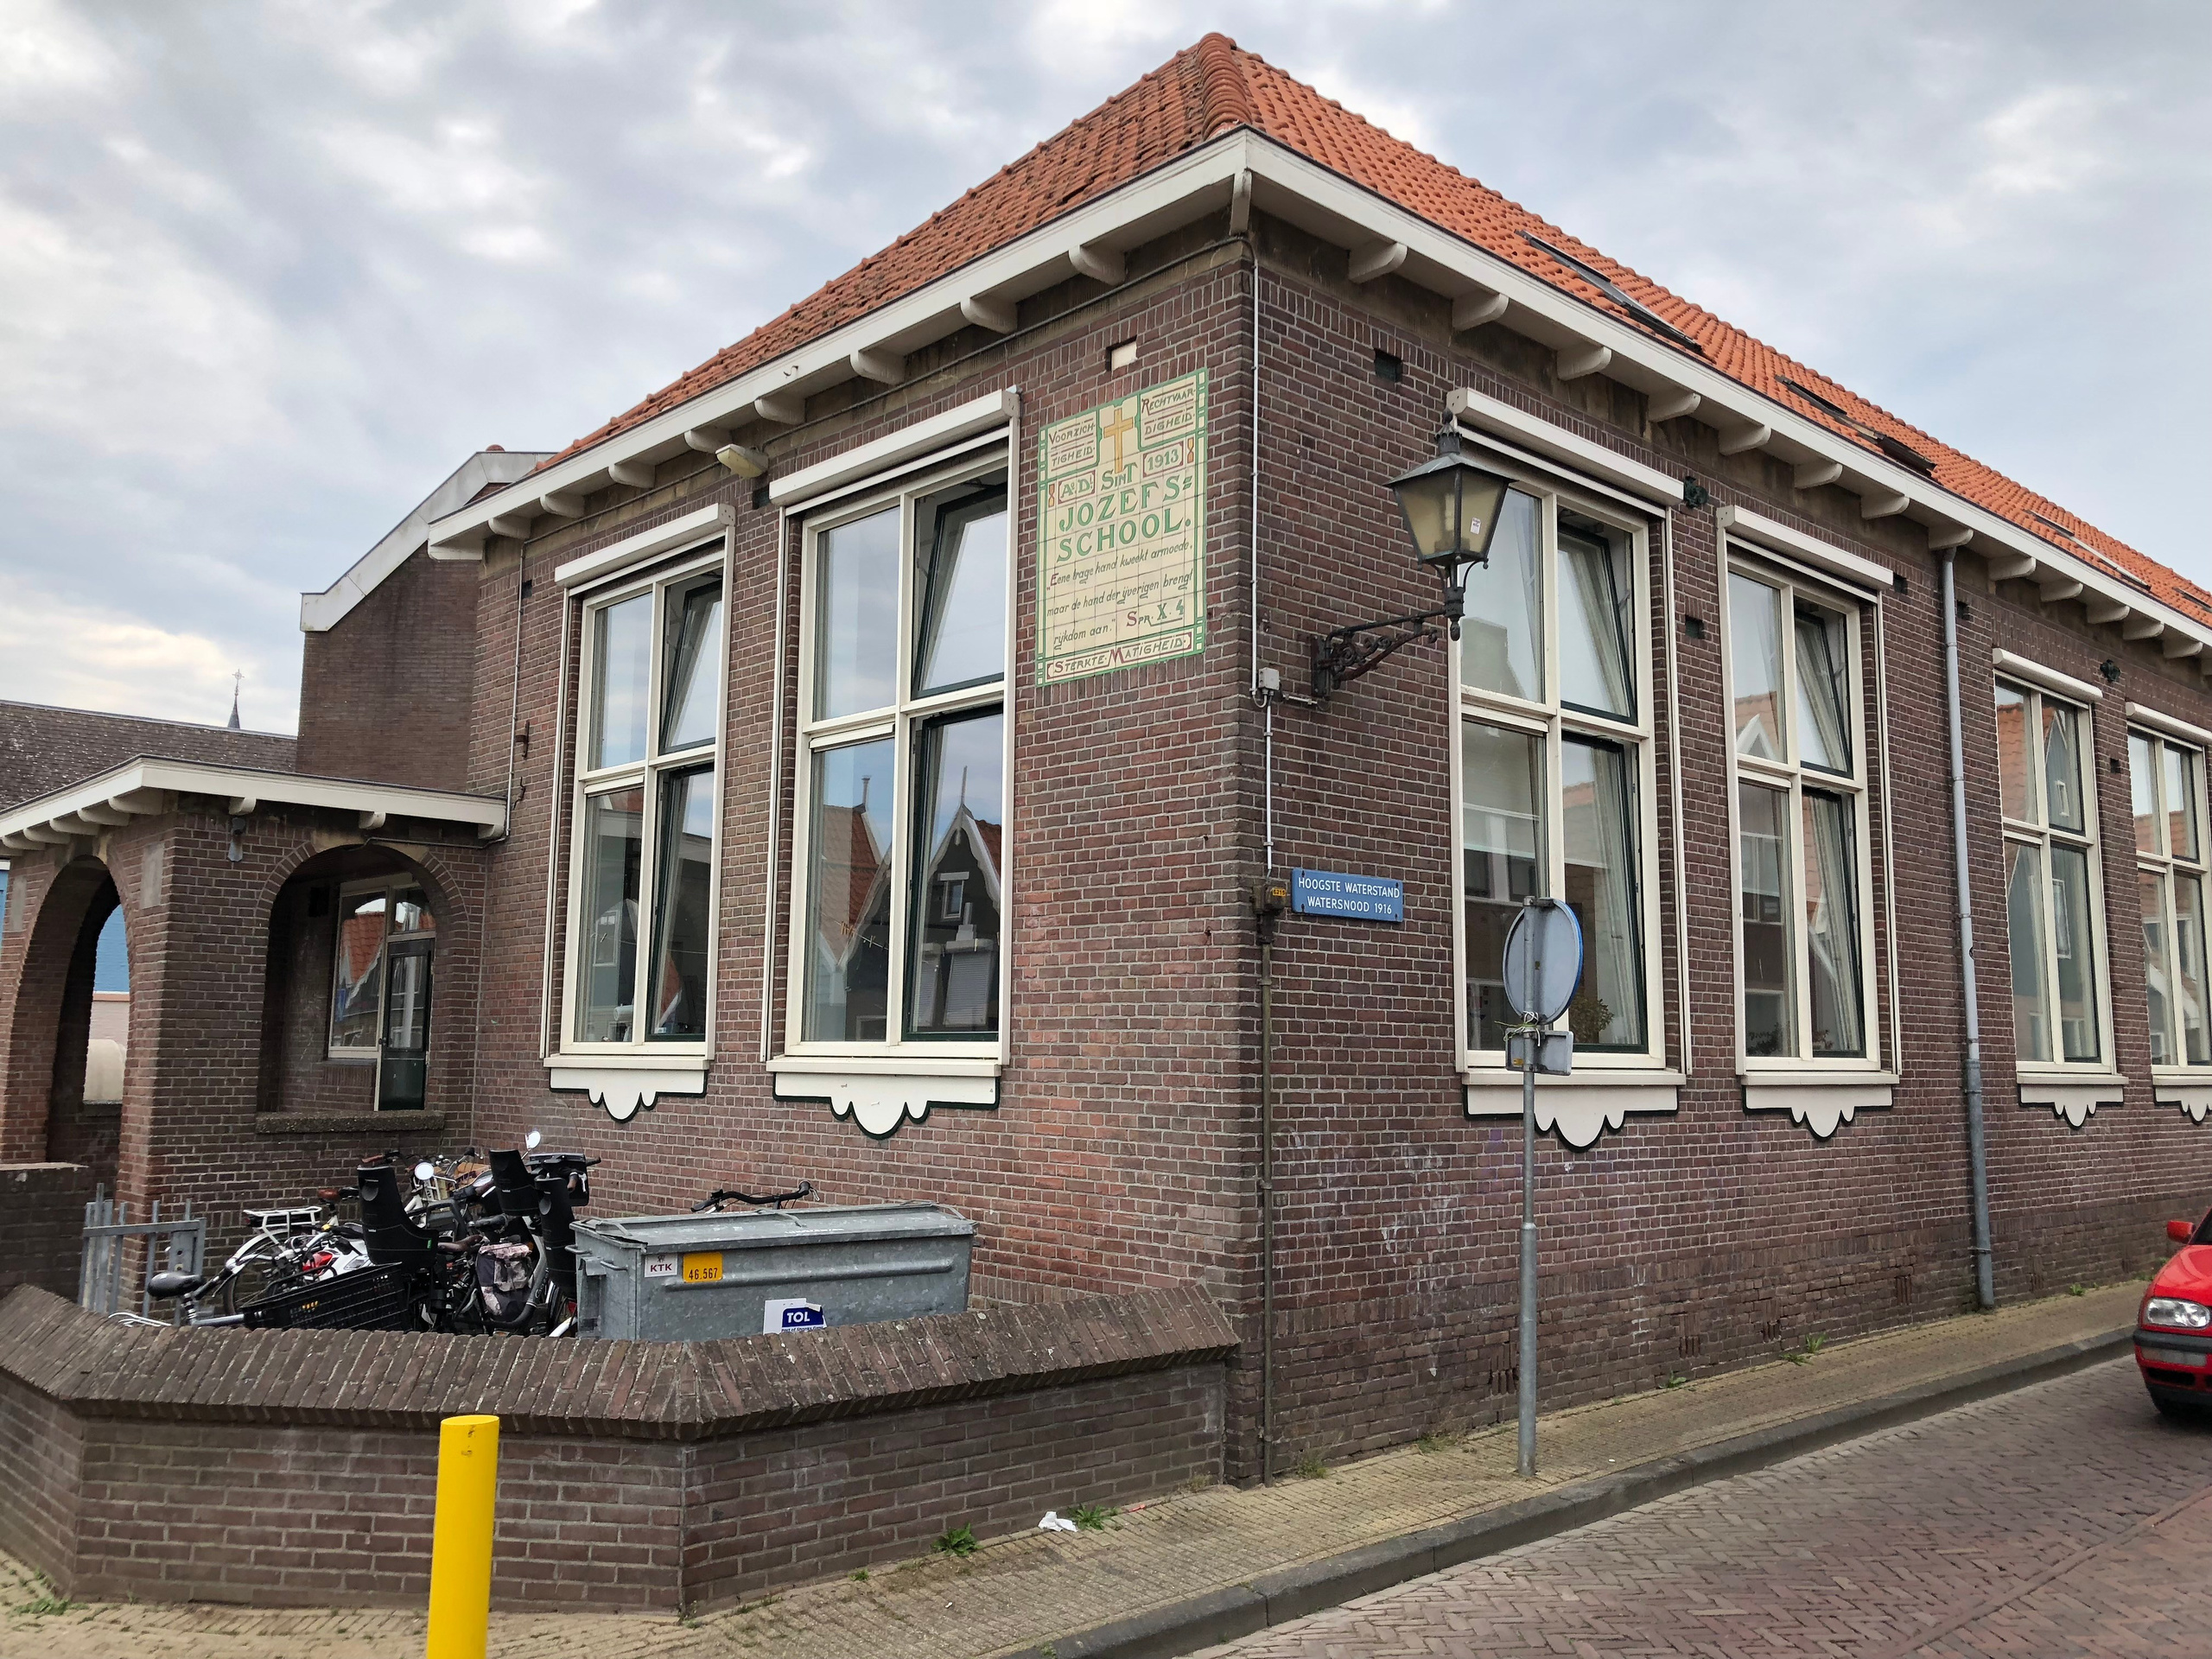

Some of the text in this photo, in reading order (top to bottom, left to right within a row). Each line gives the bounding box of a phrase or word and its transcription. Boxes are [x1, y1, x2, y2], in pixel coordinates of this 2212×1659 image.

[1147, 448, 1180, 472] 1913
[1072, 569, 1094, 584] trage
[1095, 556, 1118, 575] hand
[1119, 548, 1149, 568] kweekt
[1046, 604, 1070, 617] maar
[1071, 598, 1082, 611] de
[1083, 590, 1106, 608] hand
[1106, 588, 1122, 602] der
[1162, 568, 1194, 591] brengt
[1298, 876, 1401, 899] HOOGSTE WATERSTAND
[1306, 895, 1393, 915] WATERSNOOD 1916
[650, 1263, 673, 1273] KTK
[688, 1267, 718, 1281] 46.567
[786, 1311, 810, 1324] TOL
